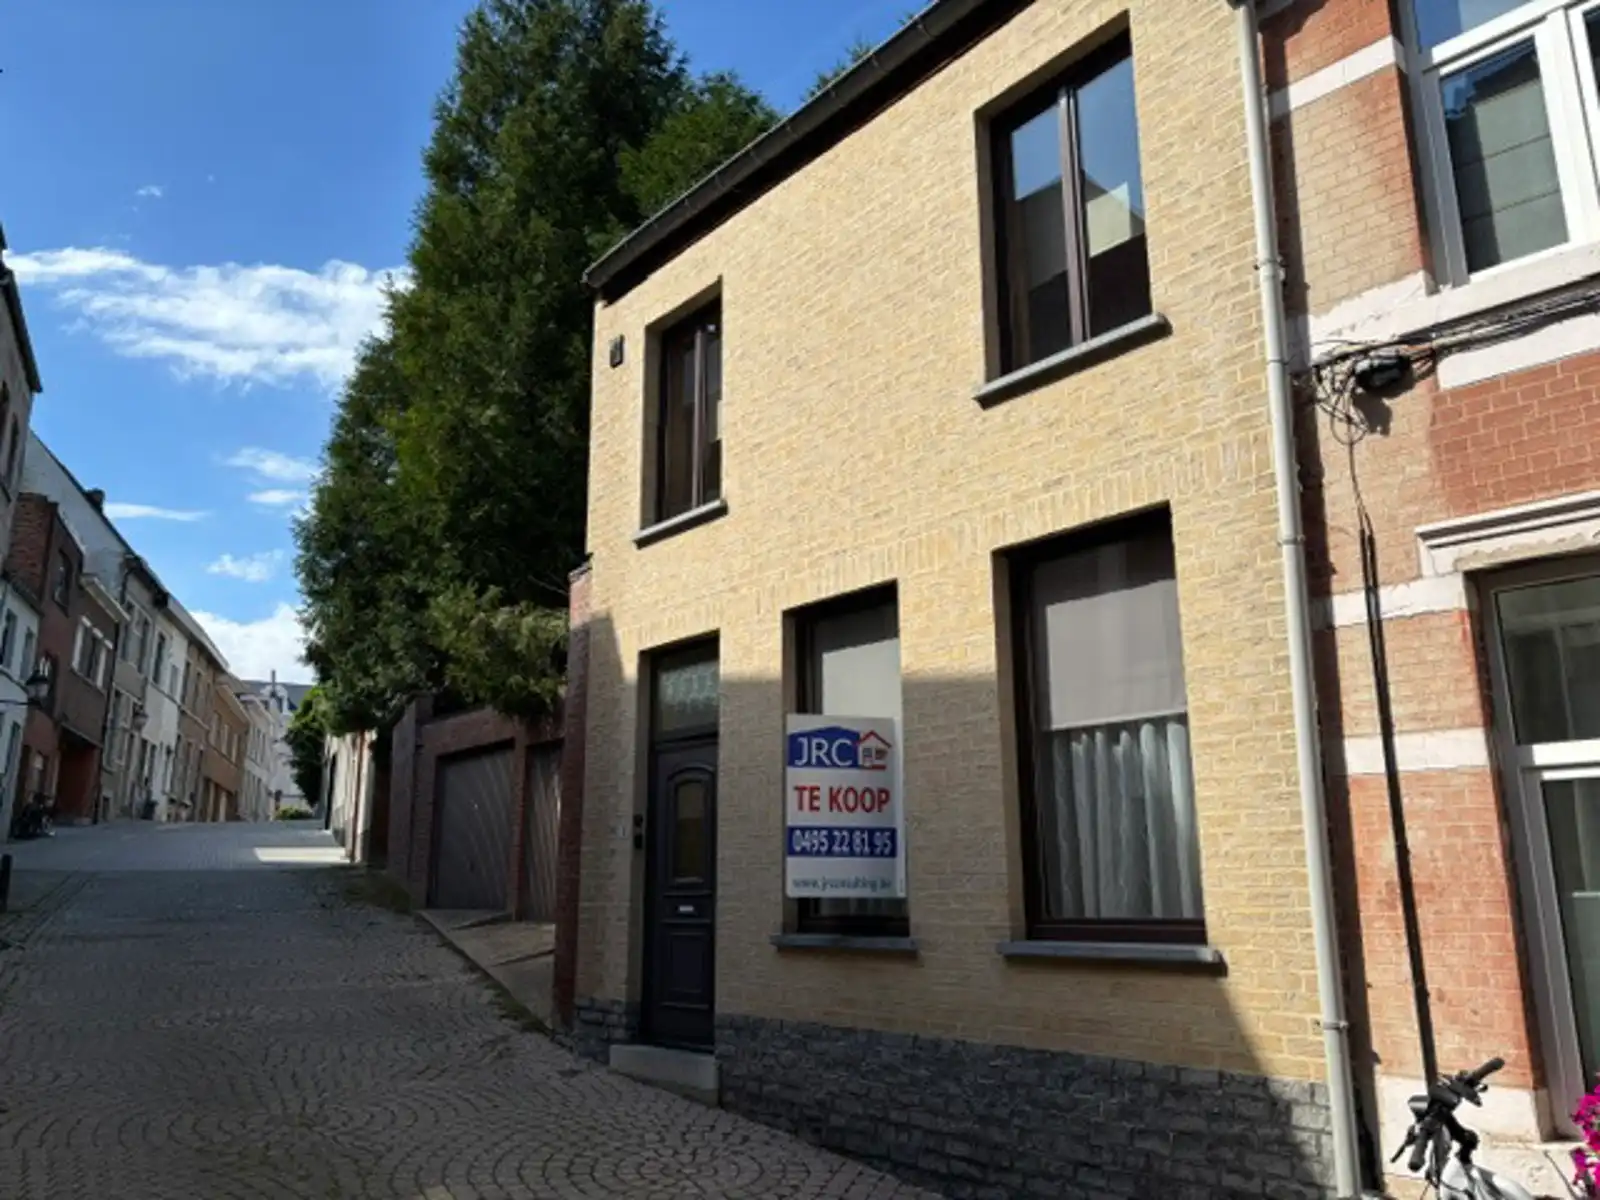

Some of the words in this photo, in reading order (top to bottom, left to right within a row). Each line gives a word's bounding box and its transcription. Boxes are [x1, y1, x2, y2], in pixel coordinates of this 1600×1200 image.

[794, 737, 853, 767] JRC
[793, 785, 821, 812] TE
[829, 786, 891, 814] KOOP
[792, 829, 829, 852] 0495
[832, 829, 850, 853] 22
[852, 830, 870, 854] 81
[873, 831, 892, 856] 95
